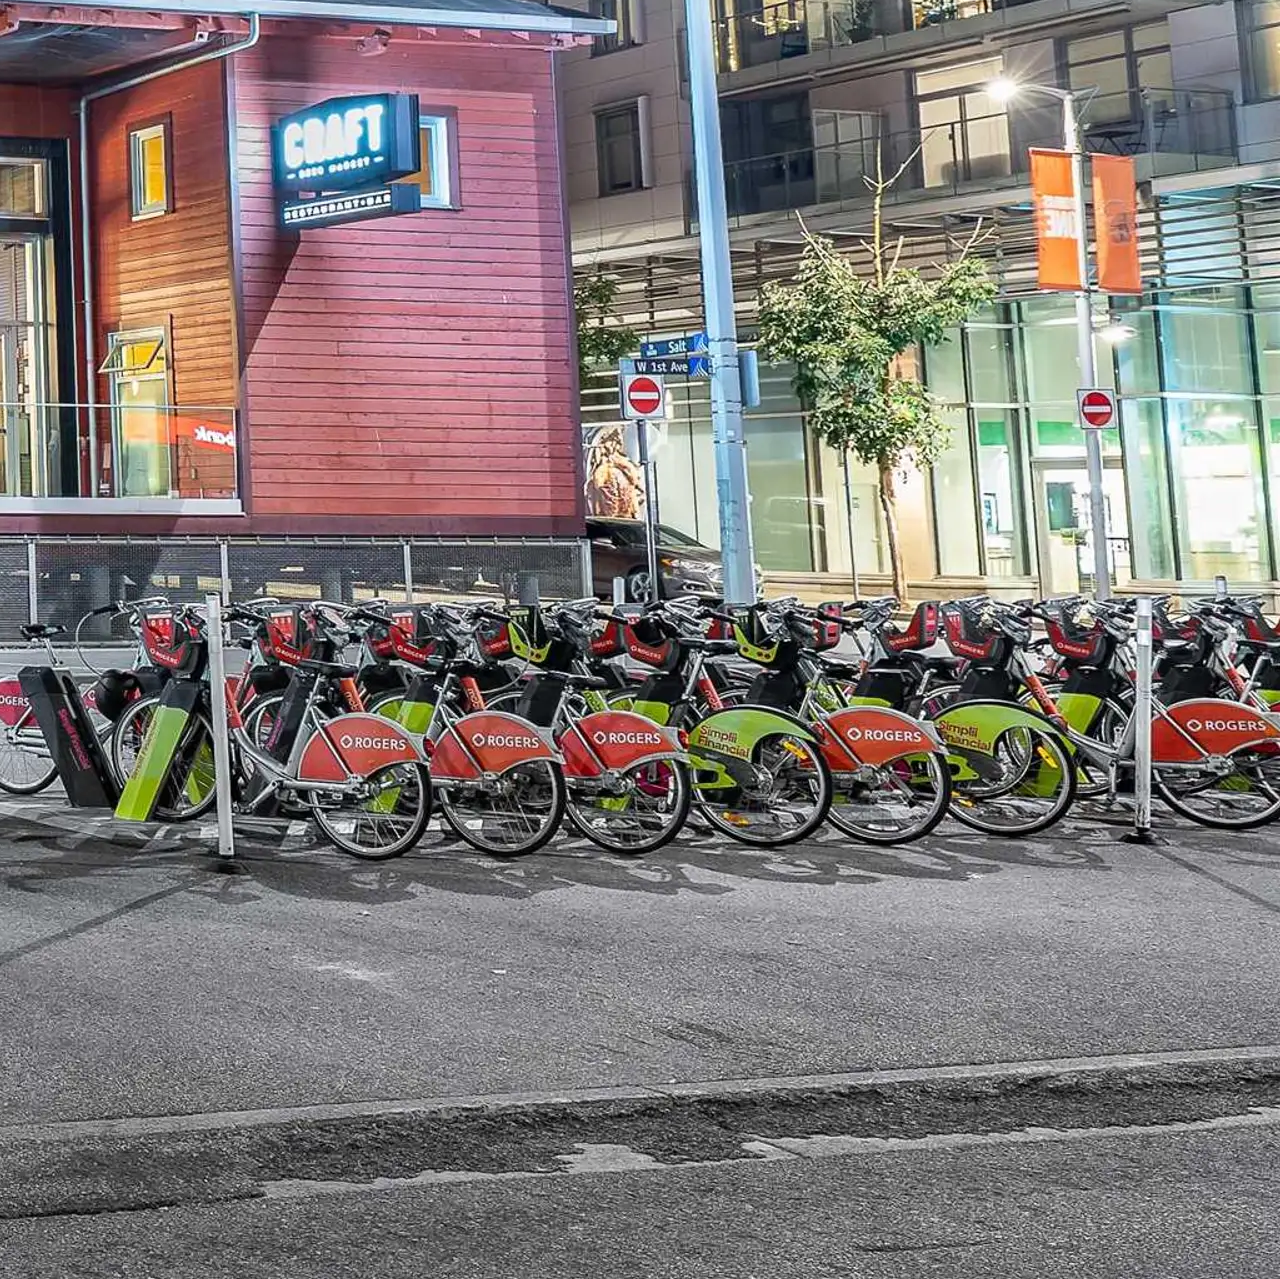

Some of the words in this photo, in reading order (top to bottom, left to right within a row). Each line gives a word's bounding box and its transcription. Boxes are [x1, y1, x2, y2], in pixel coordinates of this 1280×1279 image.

[284, 104, 384, 169] CRAFT
[668, 340, 687, 354] Salt
[636, 362, 646, 372] W
[651, 361, 667, 373] 1st
[671, 361, 689, 373] Ave
[1205, 720, 1267, 732] ROGERS
[488, 735, 540, 749] ROGERS
[608, 732, 661, 744] ROGERS
[864, 729, 922, 743] ROGERS
[355, 736, 407, 751] ROGERS
[698, 735, 751, 757] Financial
